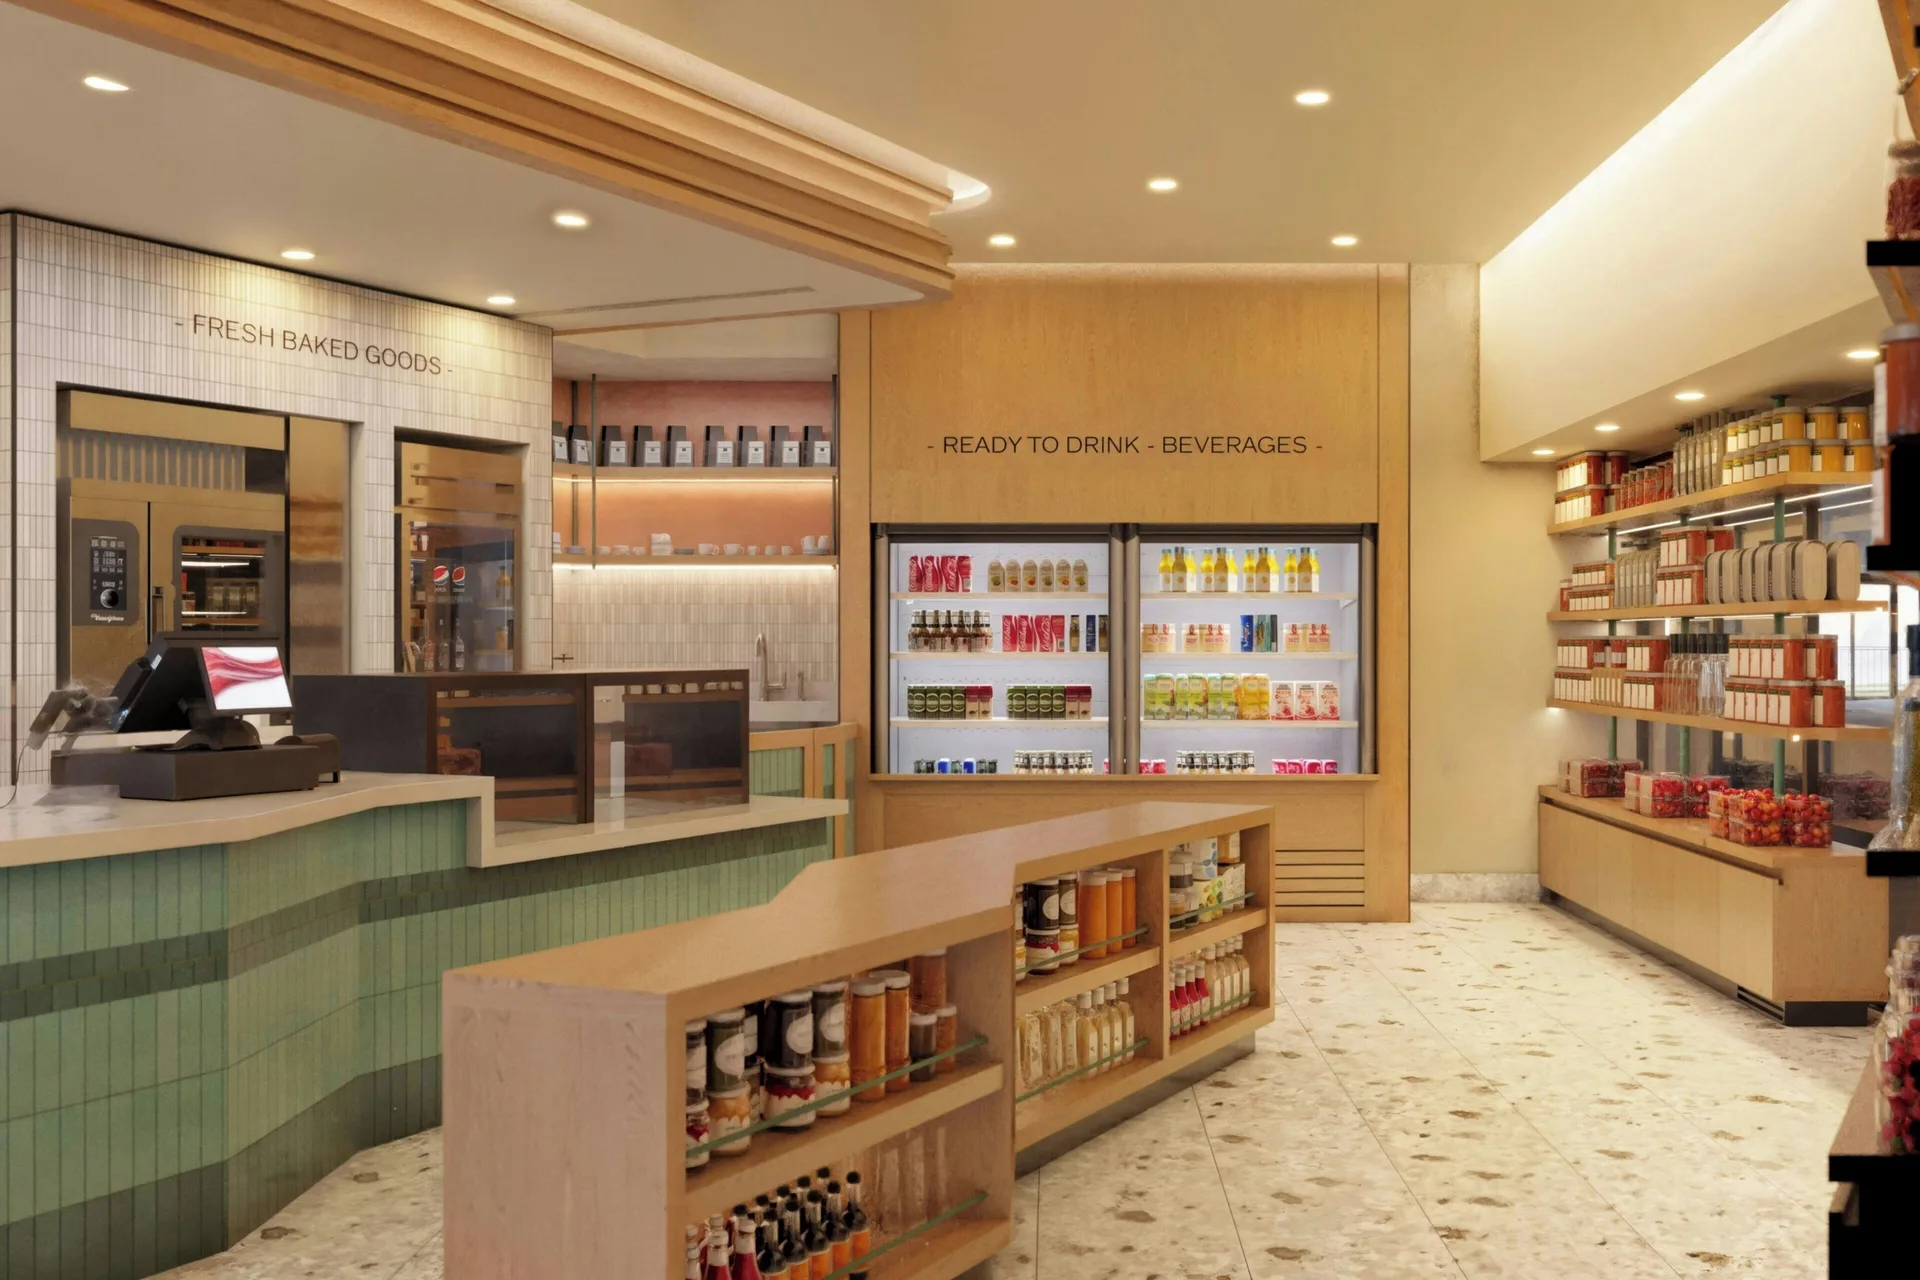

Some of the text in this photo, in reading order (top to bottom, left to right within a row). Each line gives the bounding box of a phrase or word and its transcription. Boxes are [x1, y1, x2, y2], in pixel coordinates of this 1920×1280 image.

[193, 314, 274, 347] FRESH
[282, 330, 359, 361] BAKED
[365, 344, 441, 375] GOODS
[943, 436, 1023, 454] READY
[1026, 436, 1059, 454] TO
[1066, 436, 1140, 454] DRINK
[1162, 436, 1307, 454] BEVERAGES
